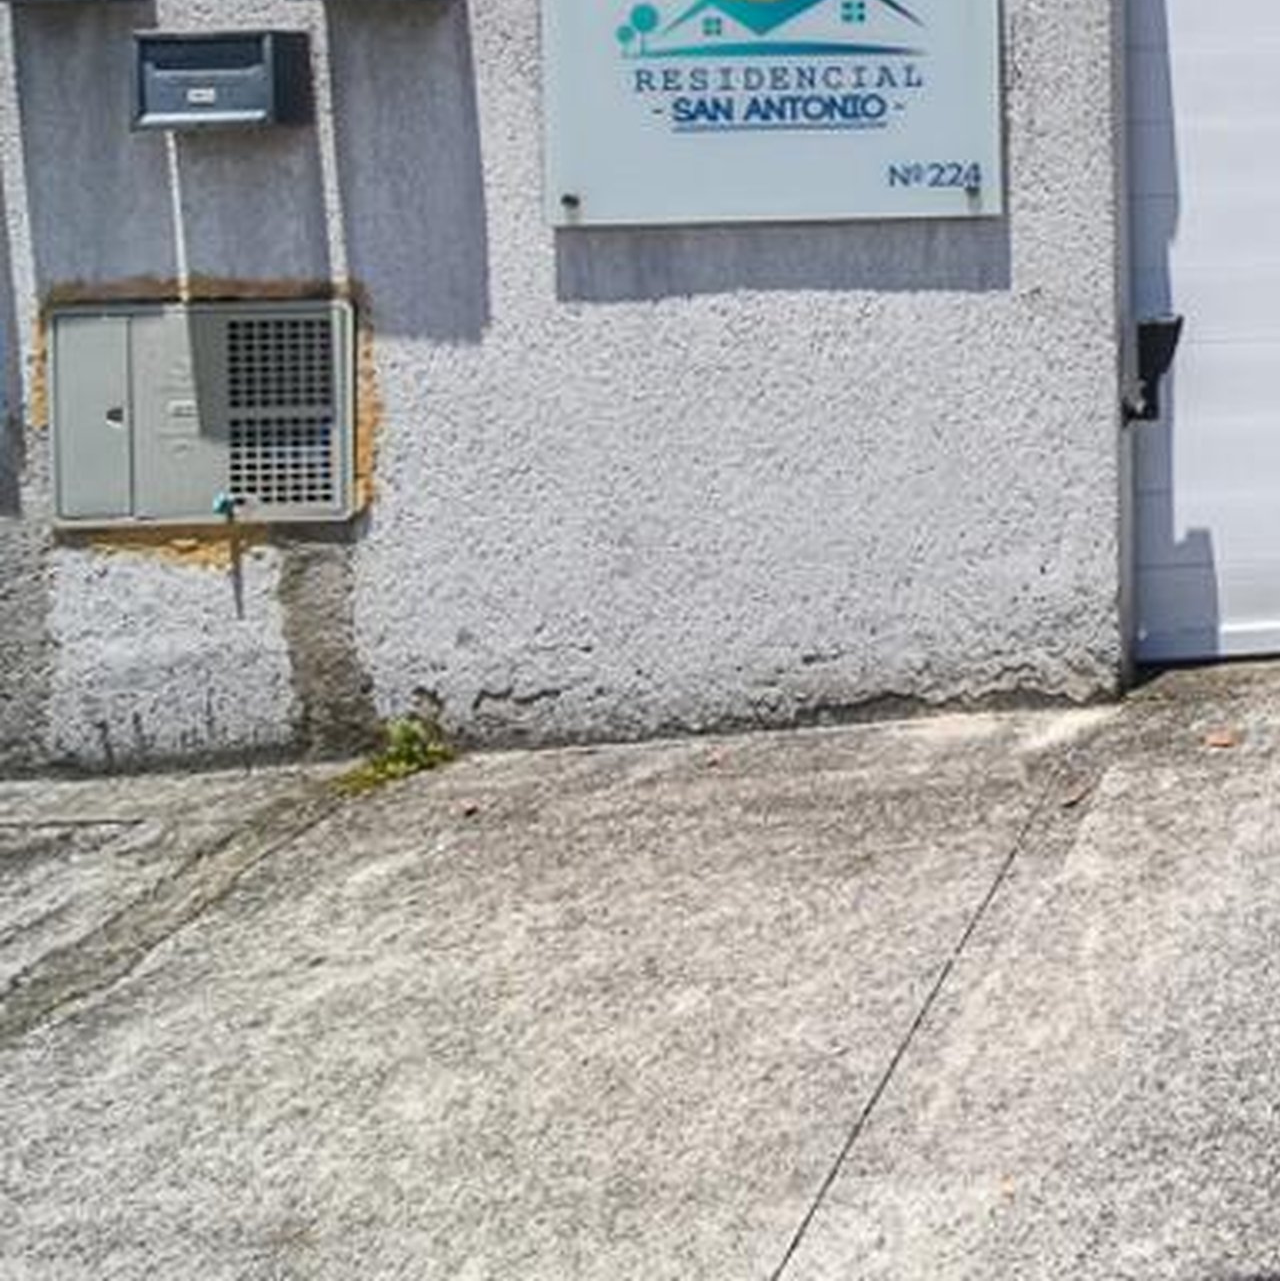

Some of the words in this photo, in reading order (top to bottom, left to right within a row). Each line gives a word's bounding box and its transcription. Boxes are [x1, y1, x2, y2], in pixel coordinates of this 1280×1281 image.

[635, 64, 923, 92] RESIDENCIAL
[672, 97, 734, 121] SAN
[743, 93, 888, 120] ANTONIO
